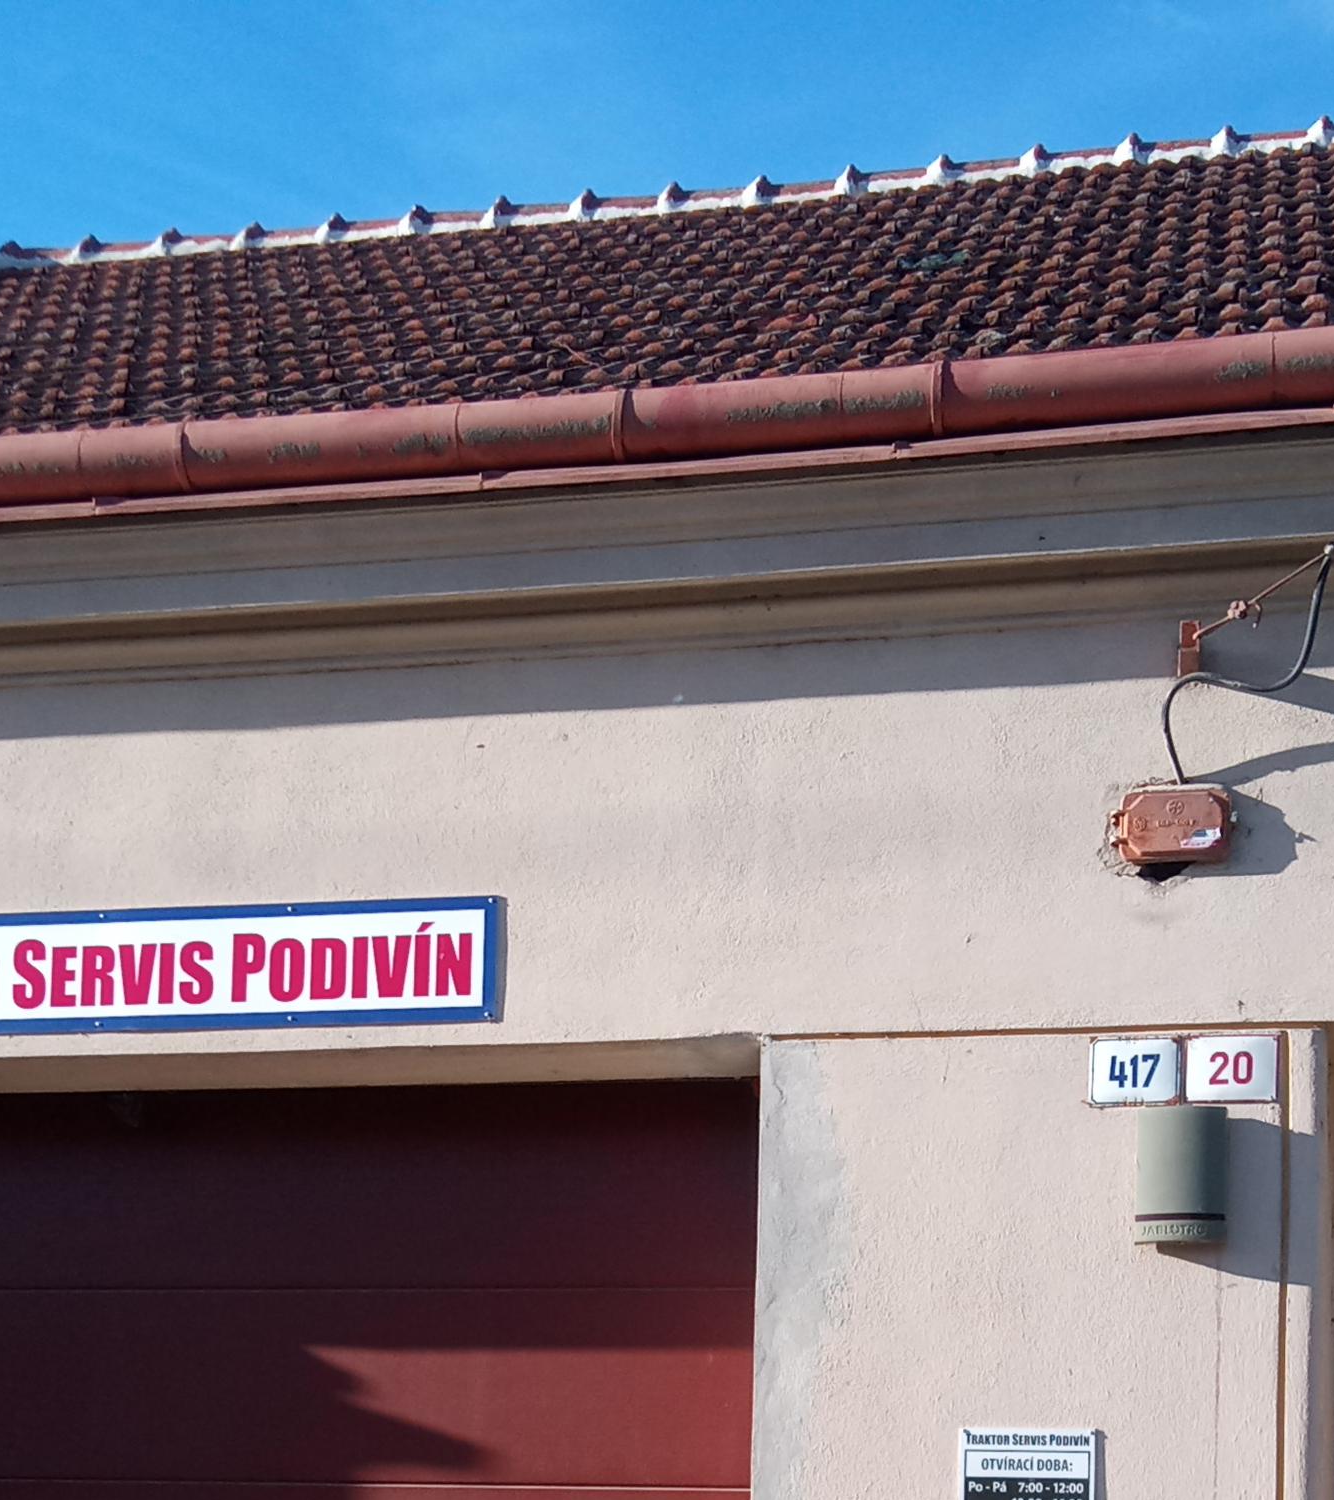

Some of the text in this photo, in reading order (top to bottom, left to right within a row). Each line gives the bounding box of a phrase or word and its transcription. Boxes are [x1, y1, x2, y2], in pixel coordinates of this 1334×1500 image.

[12, 938, 214, 1009] SERVIS
[231, 922, 473, 1002] PODIVÍN
[1109, 1053, 1161, 1088] 417
[1209, 1051, 1253, 1085] 20
[966, 1433, 1090, 1447] TRAKTOR SERVIS PODIVÍN
[981, 1456, 1073, 1473] OTVÍRACÍ DOBA:
[968, 1481, 983, 1492] Po
[992, 1481, 1007, 1493] Pá
[1018, 1482, 1043, 1493] 7:00
[1053, 1483, 1084, 1494] 12:00
